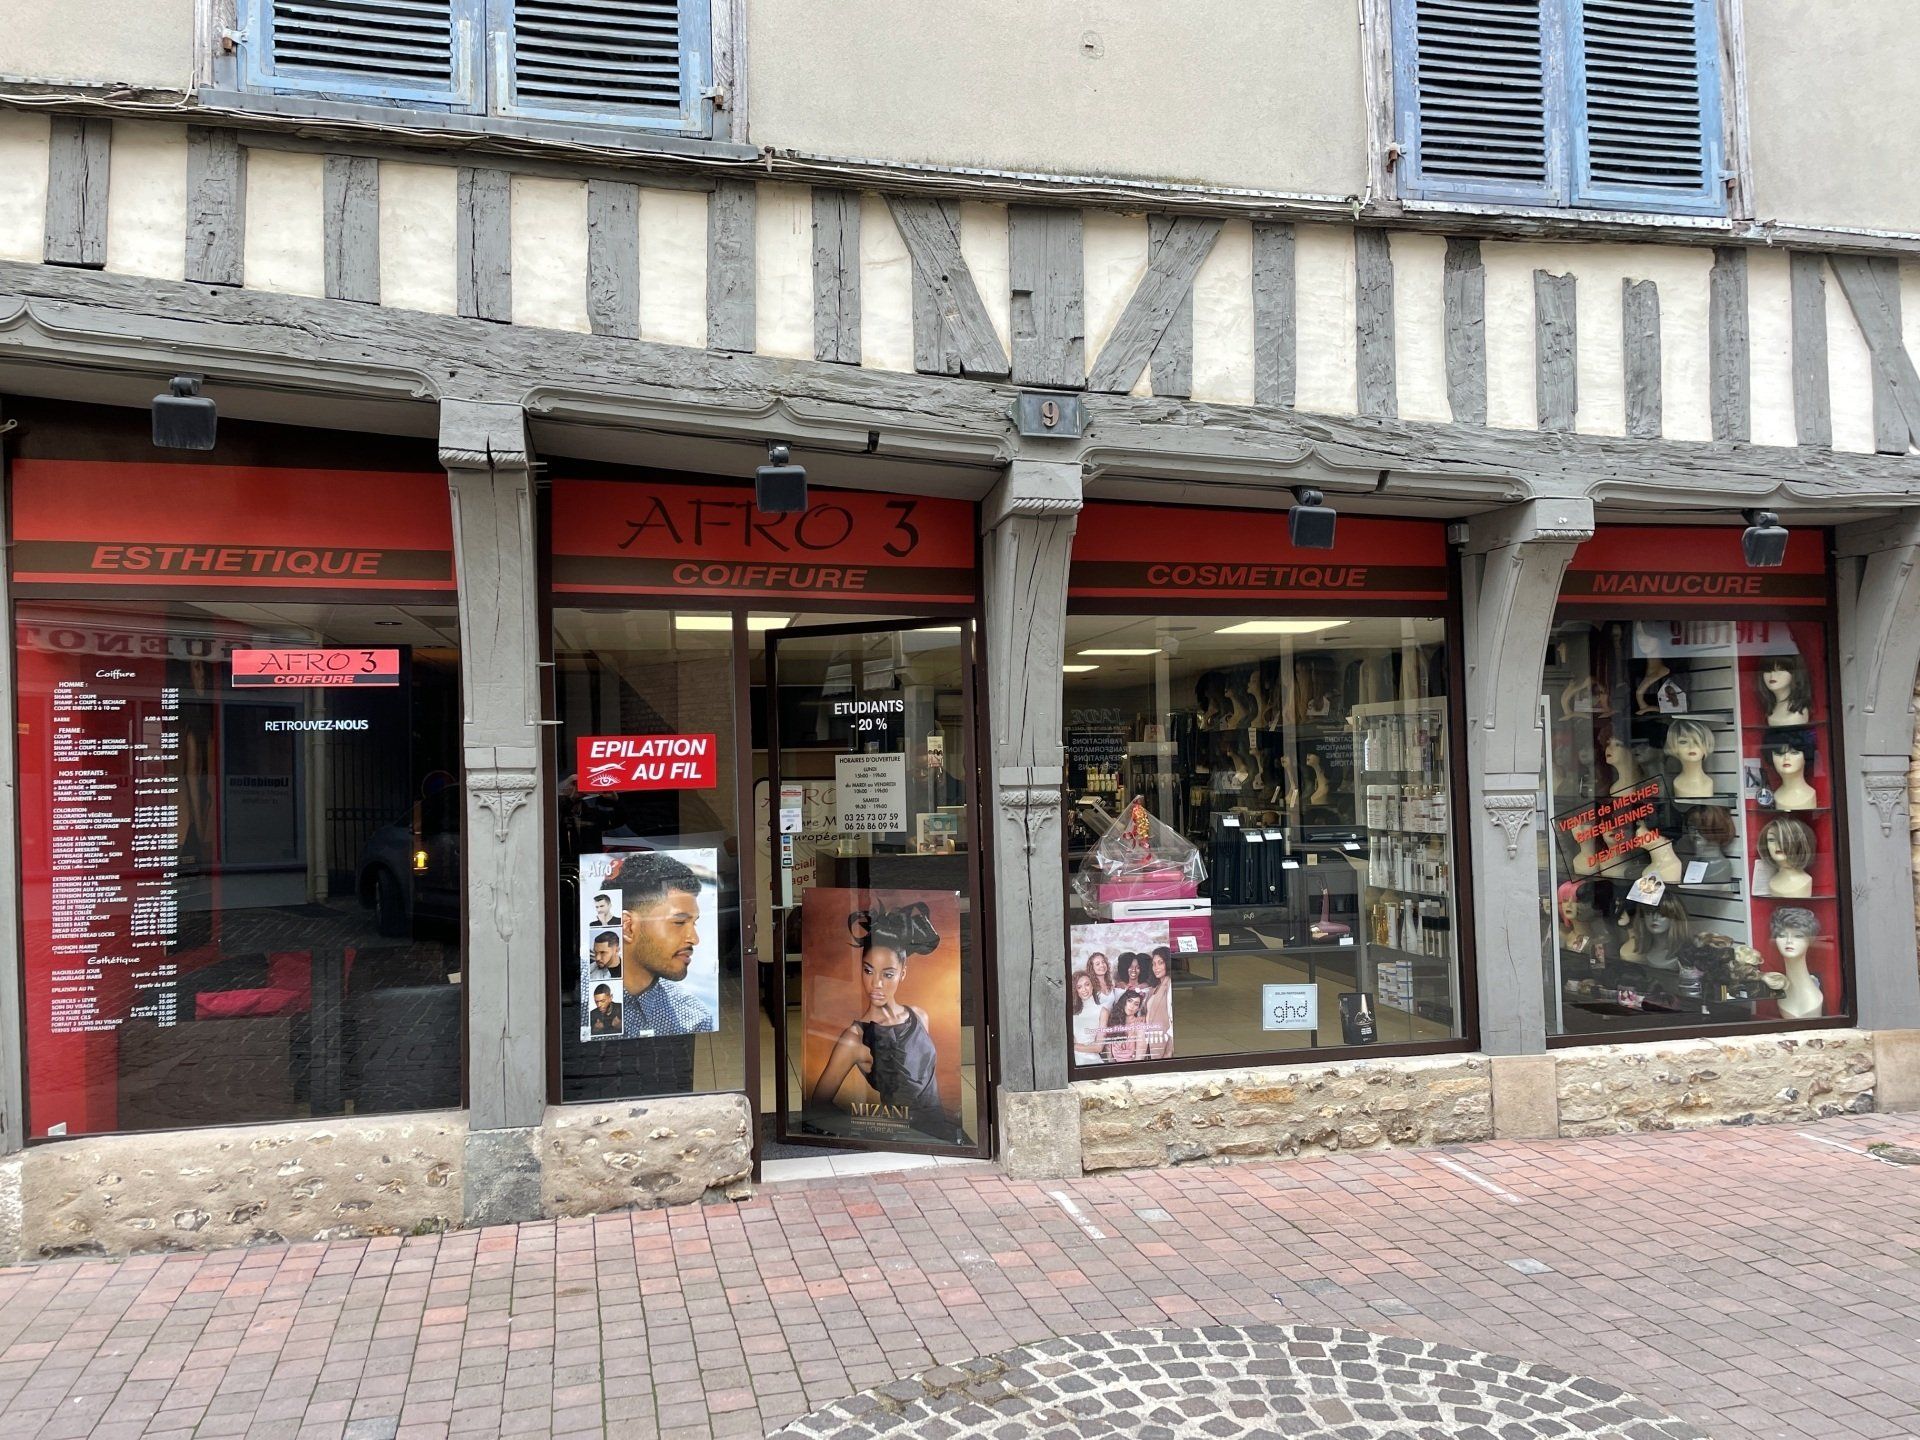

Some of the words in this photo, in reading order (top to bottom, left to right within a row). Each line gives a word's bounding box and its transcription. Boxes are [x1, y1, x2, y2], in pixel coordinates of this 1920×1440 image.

[1041, 400, 1060, 427] 9
[618, 496, 854, 553] AFRO
[883, 500, 920, 558] 3
[91, 545, 382, 576] ESTHETIQUE
[672, 563, 868, 590] COIFFURE
[1146, 565, 1368, 587] COSMETIQUE
[1592, 574, 1763, 594] MANUCURE
[257, 651, 350, 674] AFRO
[359, 651, 377, 674] 3
[96, 670, 136, 679] Coiffure
[273, 674, 354, 685] COIFFURE
[835, 700, 903, 714] ETUDIANTS
[265, 719, 369, 732] RETROUVEZ-NOUS
[859, 719, 872, 730] 20
[876, 718, 887, 730] %
[591, 739, 706, 758] EPILATION
[631, 763, 665, 781] AU
[670, 761, 702, 780] FIL
[1558, 811, 1596, 832] VENTE
[1597, 804, 1612, 818] de
[1612, 783, 1660, 811] MECHES
[1576, 803, 1655, 842] BRESILIENNES
[1587, 828, 1660, 868] D'EXTENSION
[88, 957, 140, 965] Esthétique
[1273, 1000, 1308, 1024] ghd
[851, 1103, 910, 1120] MIZANI
